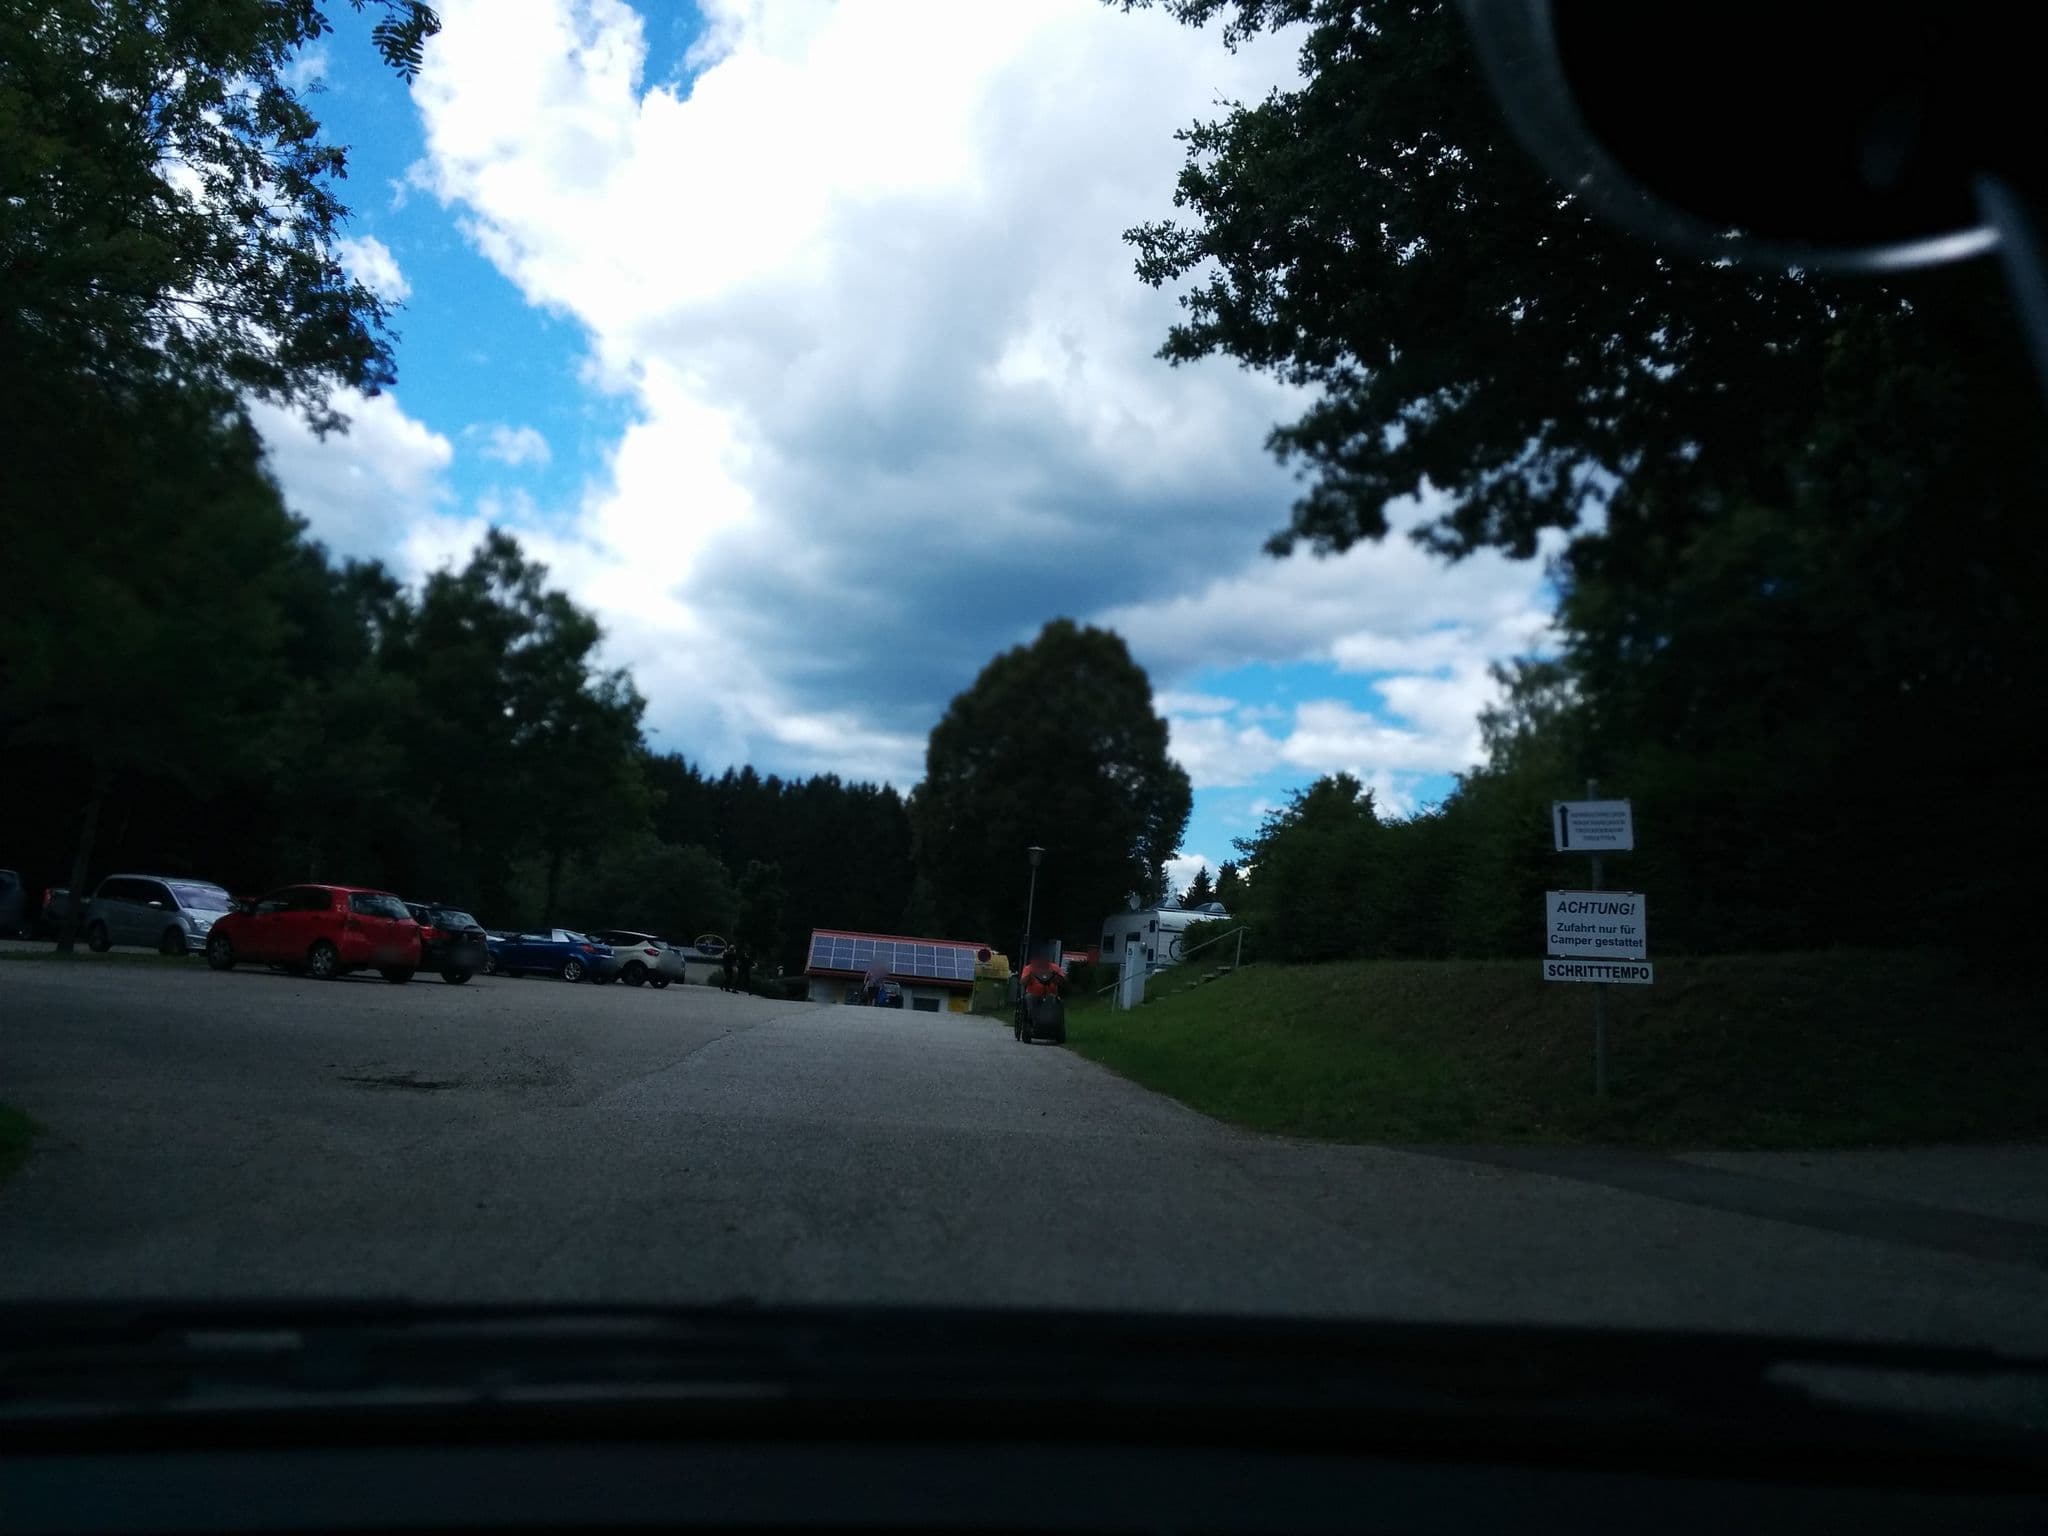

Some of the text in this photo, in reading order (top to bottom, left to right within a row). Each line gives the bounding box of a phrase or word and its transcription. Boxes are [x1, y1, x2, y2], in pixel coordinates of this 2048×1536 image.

[1557, 901, 1635, 915] ACHTUNG!
[1557, 923, 1636, 935] Zufahrt nur für
[1551, 935, 1643, 948] Camper gestattet
[1548, 964, 1649, 980] SCHRITTTEMPO
